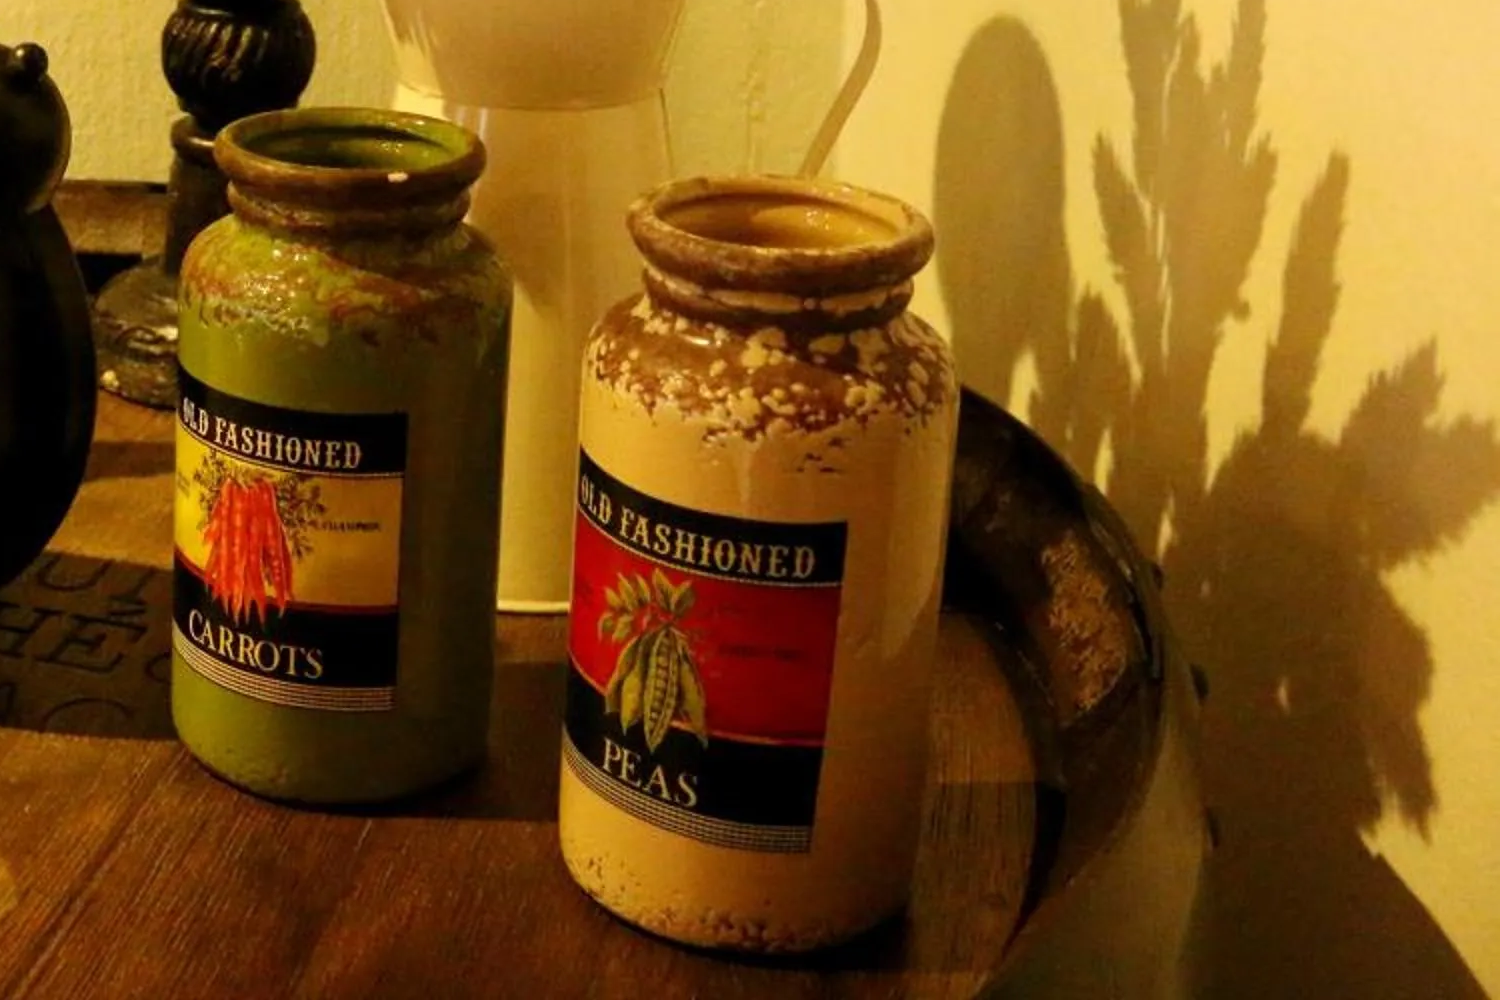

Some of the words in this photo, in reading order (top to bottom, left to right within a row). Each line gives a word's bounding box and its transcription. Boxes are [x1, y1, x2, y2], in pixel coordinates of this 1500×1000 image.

[182, 396, 210, 435] OLD
[215, 415, 363, 470] FASHIONED
[580, 473, 613, 524] OLD
[619, 505, 817, 579] FASHIONED
[188, 608, 324, 680] CARROTS
[602, 736, 699, 807] PEAS
